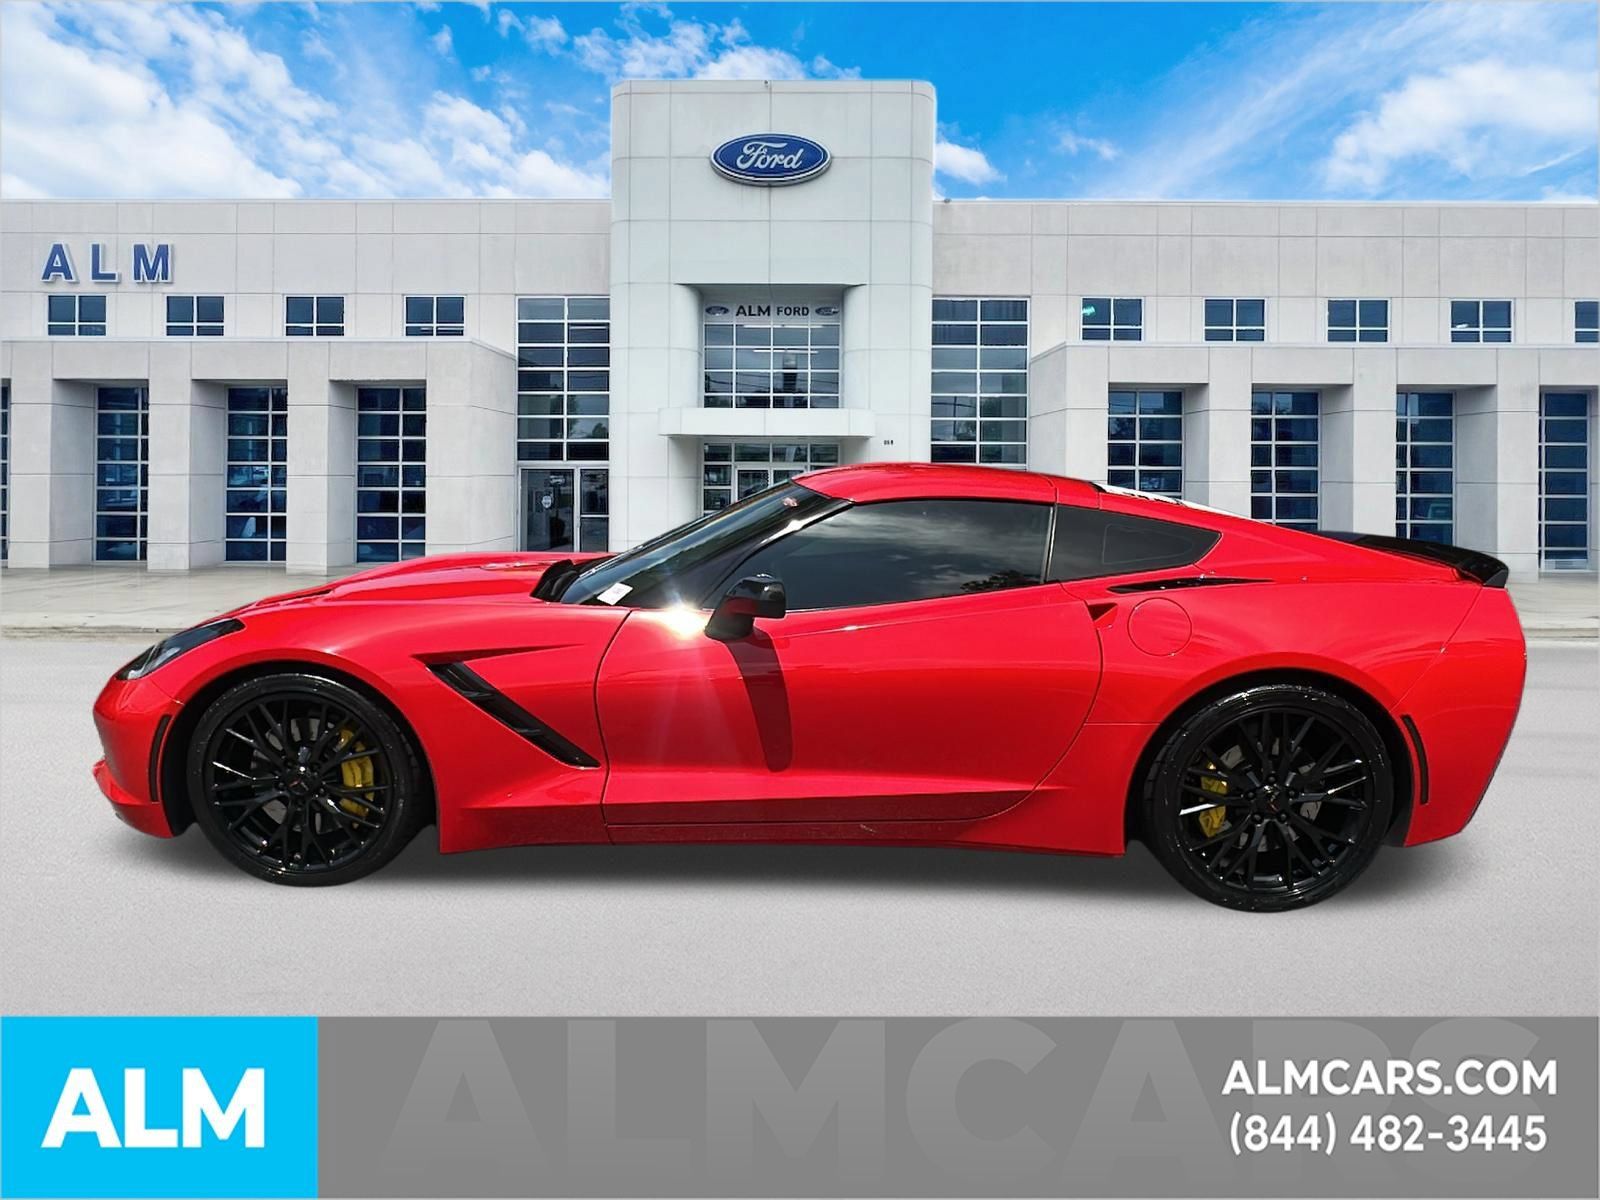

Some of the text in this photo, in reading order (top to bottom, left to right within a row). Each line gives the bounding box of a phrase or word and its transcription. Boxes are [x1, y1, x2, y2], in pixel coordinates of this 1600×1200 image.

[736, 141, 804, 170] Ford
[41, 243, 170, 281] ALM
[736, 305, 771, 317] ALM
[776, 306, 810, 317] FORD
